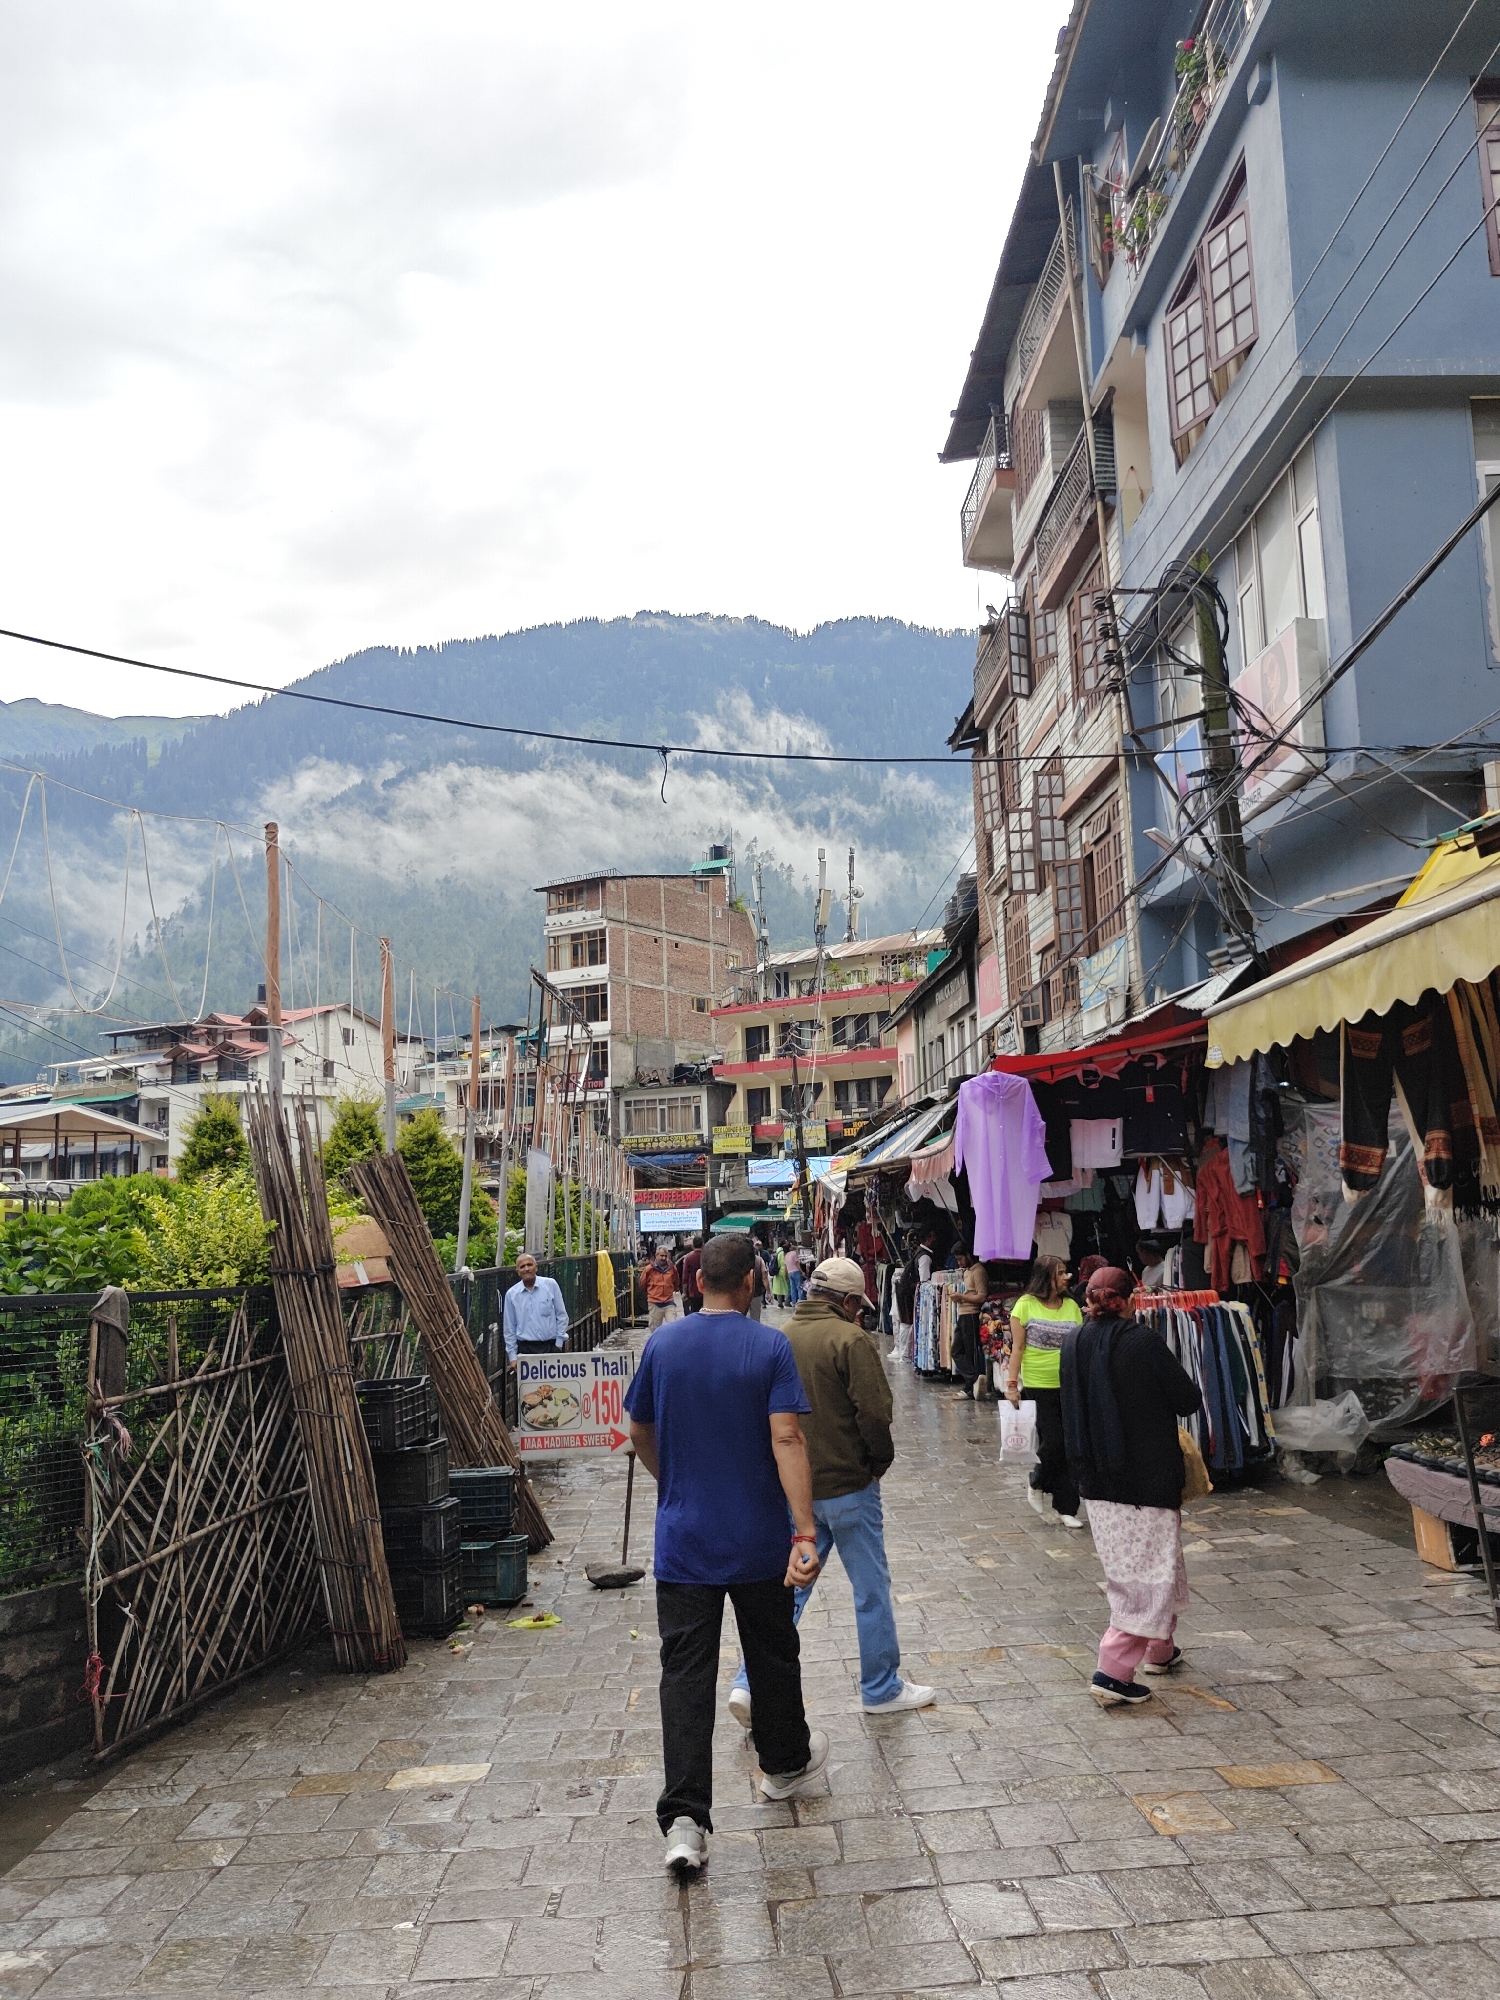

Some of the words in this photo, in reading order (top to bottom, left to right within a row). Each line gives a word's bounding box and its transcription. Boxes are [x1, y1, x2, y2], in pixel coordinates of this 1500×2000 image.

[1091, 944, 1117, 975] BABA
[635, 1192, 652, 1203] CAFE
[654, 1190, 681, 1202] COFFEE
[682, 1189, 705, 1201] DRIPS
[520, 1359, 587, 1380] Delicious
[591, 1355, 628, 1376] Thali
[524, 1437, 541, 1450] MAA
[544, 1435, 581, 1448] HADIMBA
[582, 1434, 615, 1447] SWEETS
